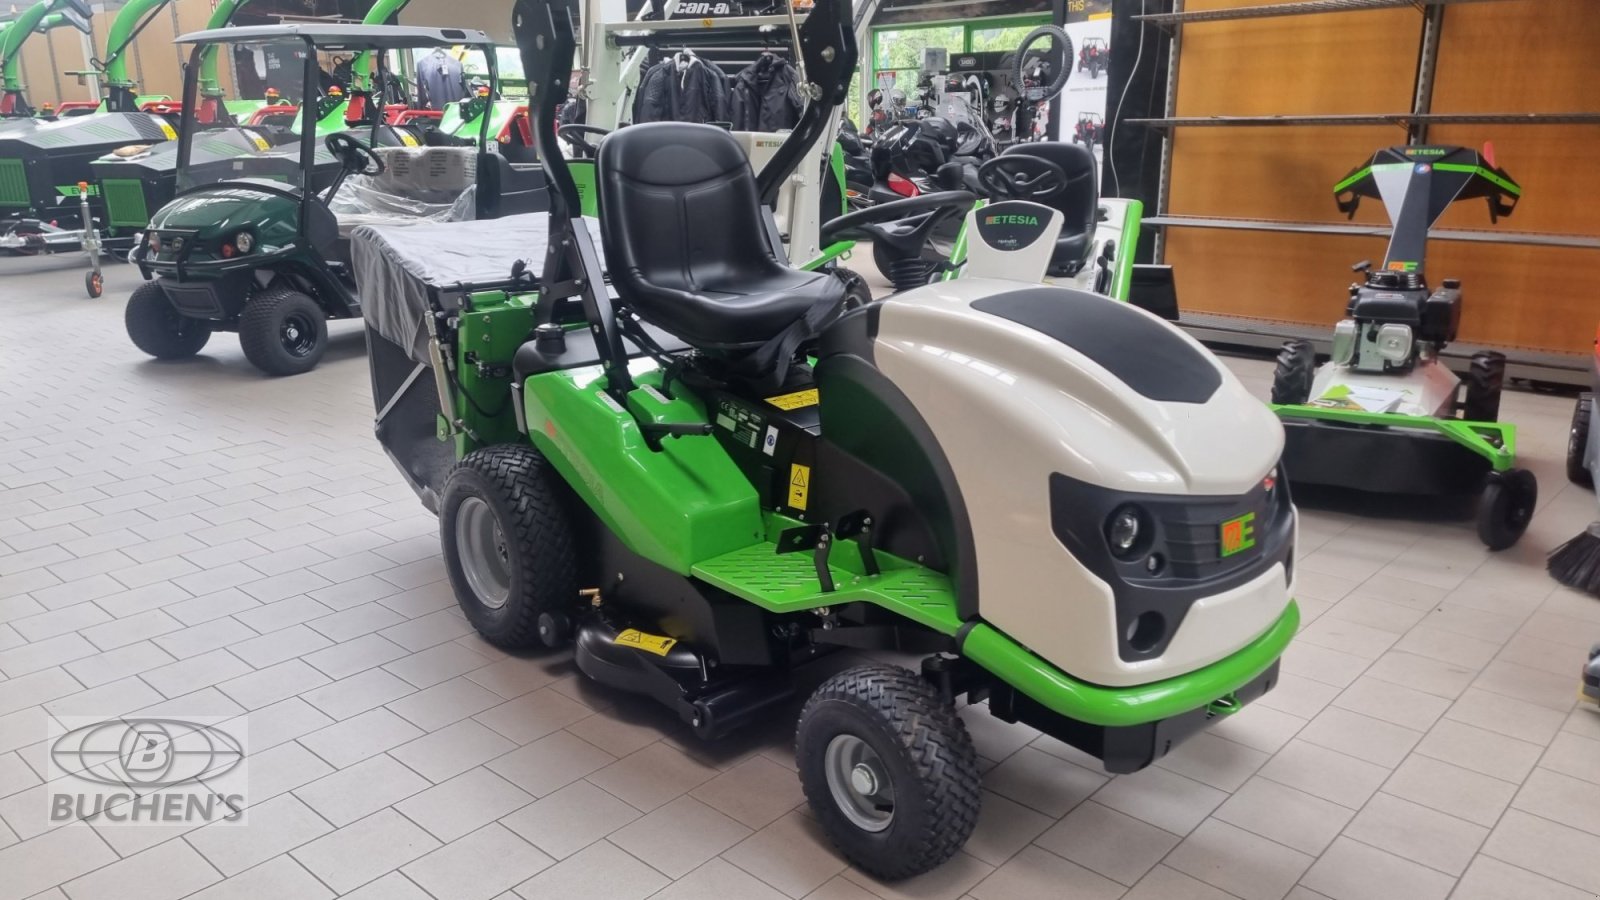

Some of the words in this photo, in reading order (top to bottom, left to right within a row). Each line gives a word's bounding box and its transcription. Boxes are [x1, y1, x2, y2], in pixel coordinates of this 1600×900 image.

[674, 2, 730, 15] can-a
[1067, 1, 1085, 12] THIS
[1405, 148, 1446, 156] ETESIA
[985, 215, 1039, 226] ETESIA
